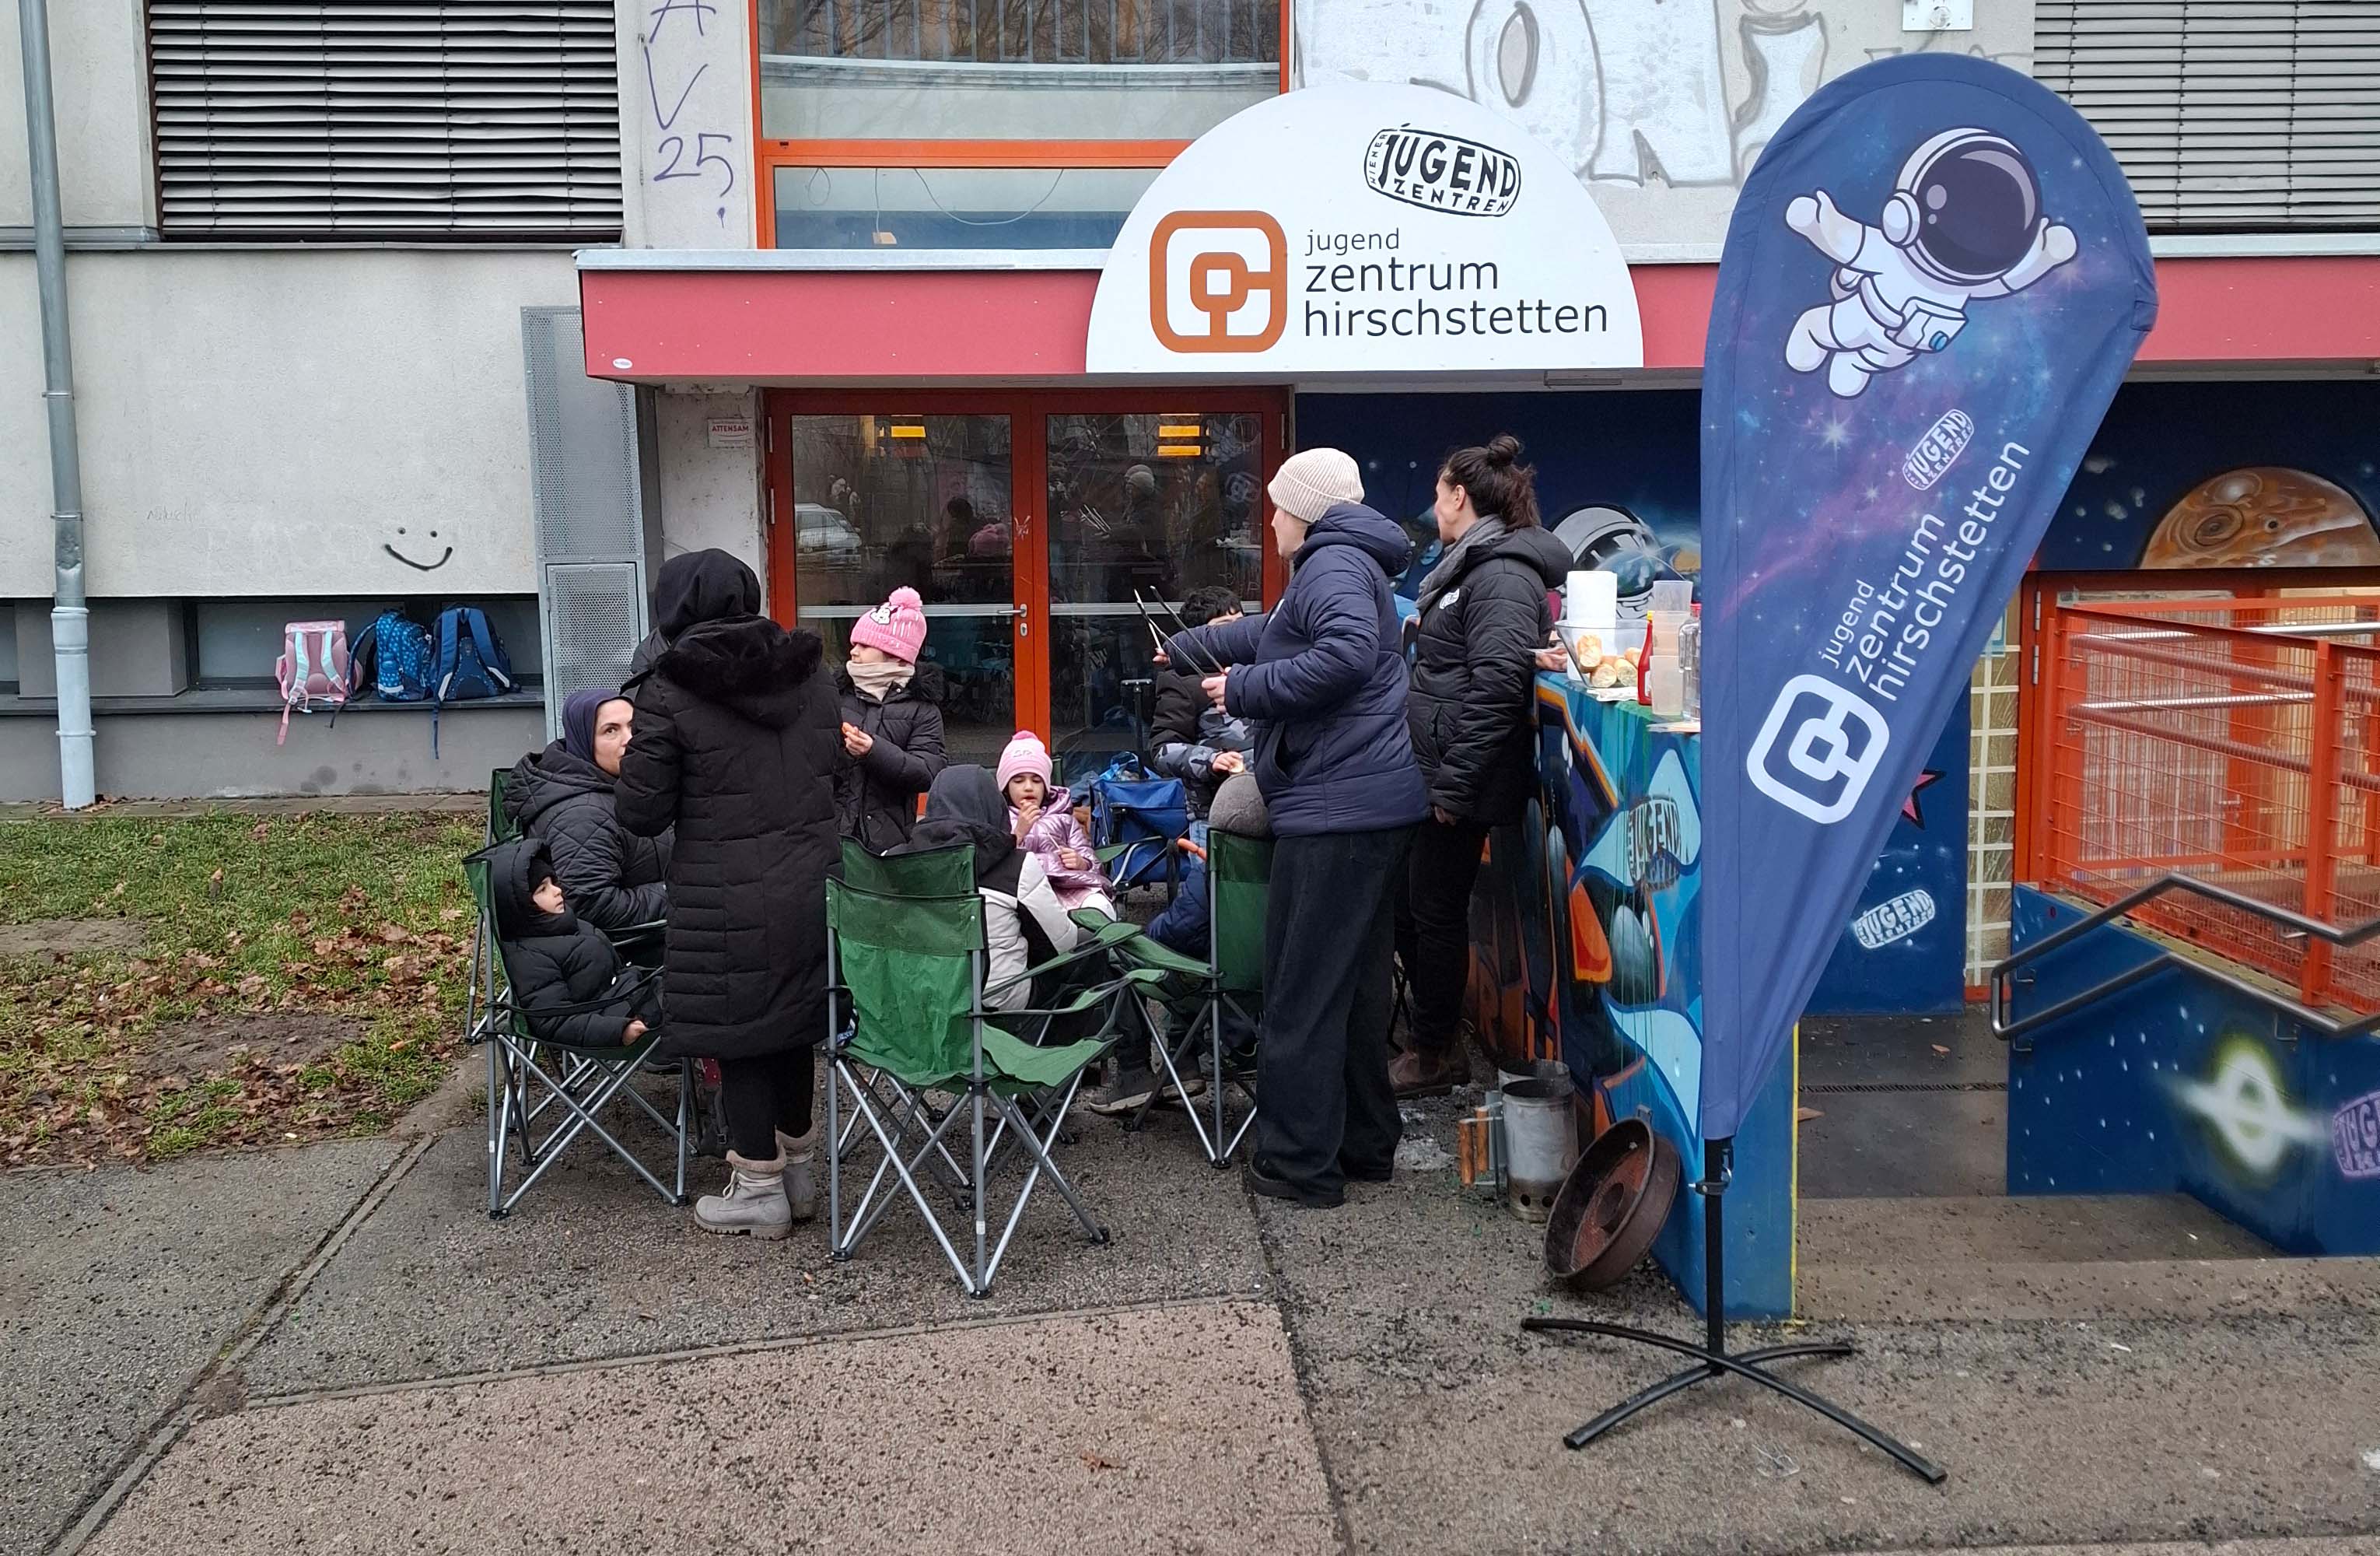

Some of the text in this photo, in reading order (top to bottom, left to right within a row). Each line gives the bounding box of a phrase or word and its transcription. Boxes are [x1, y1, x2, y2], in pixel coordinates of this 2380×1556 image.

[1368, 134, 1388, 185] WIENER
[1378, 128, 1517, 198] JUGEND
[1394, 178, 1510, 212] ZENTREN
[1305, 229, 1400, 257] jugend
[1305, 256, 1499, 293] zentrum
[1305, 298, 1608, 338] hirschstetten
[1907, 412, 1967, 485] JUGEND
[1846, 513, 1946, 684] zentrum
[1869, 441, 2030, 701] hirschstetten
[1818, 579, 1875, 669] jugend
[1632, 802, 1682, 881] JUGEND
[1860, 893, 1930, 945] JUGEND
